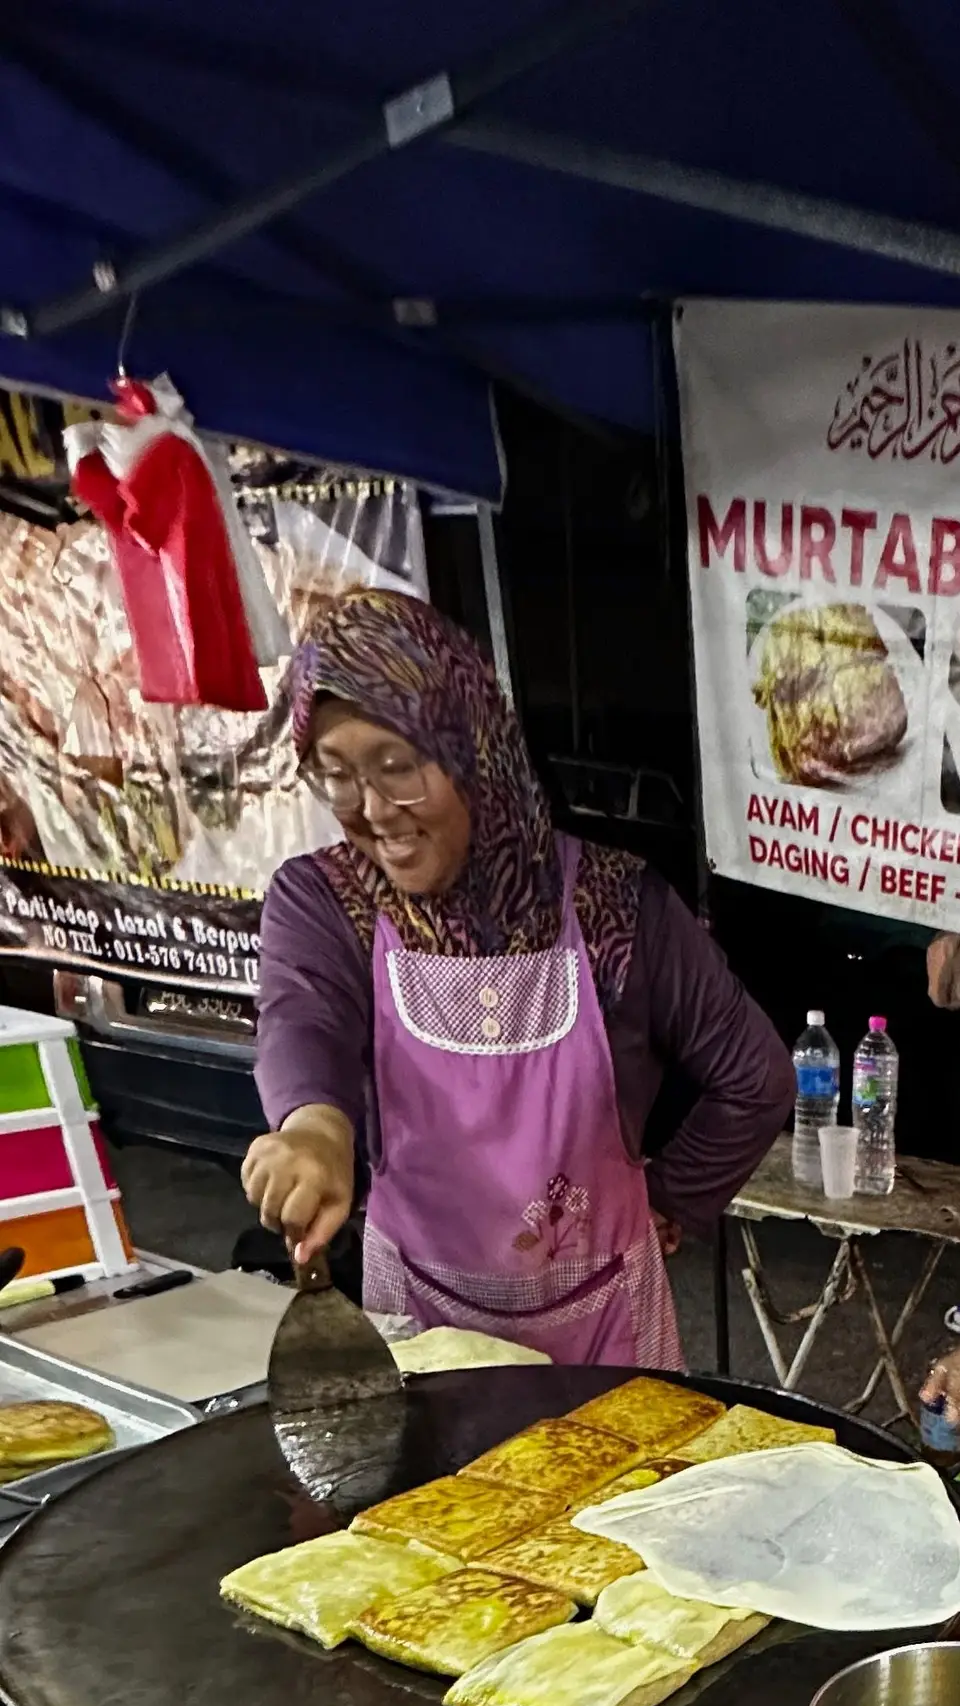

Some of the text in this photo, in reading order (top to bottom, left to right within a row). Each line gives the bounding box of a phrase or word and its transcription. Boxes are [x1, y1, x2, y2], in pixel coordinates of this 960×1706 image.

[746, 793, 820, 837] AYAM
[748, 835, 850, 885] DAGING
[880, 864, 946, 905] BEEF
[41, 924, 67, 950] NO
